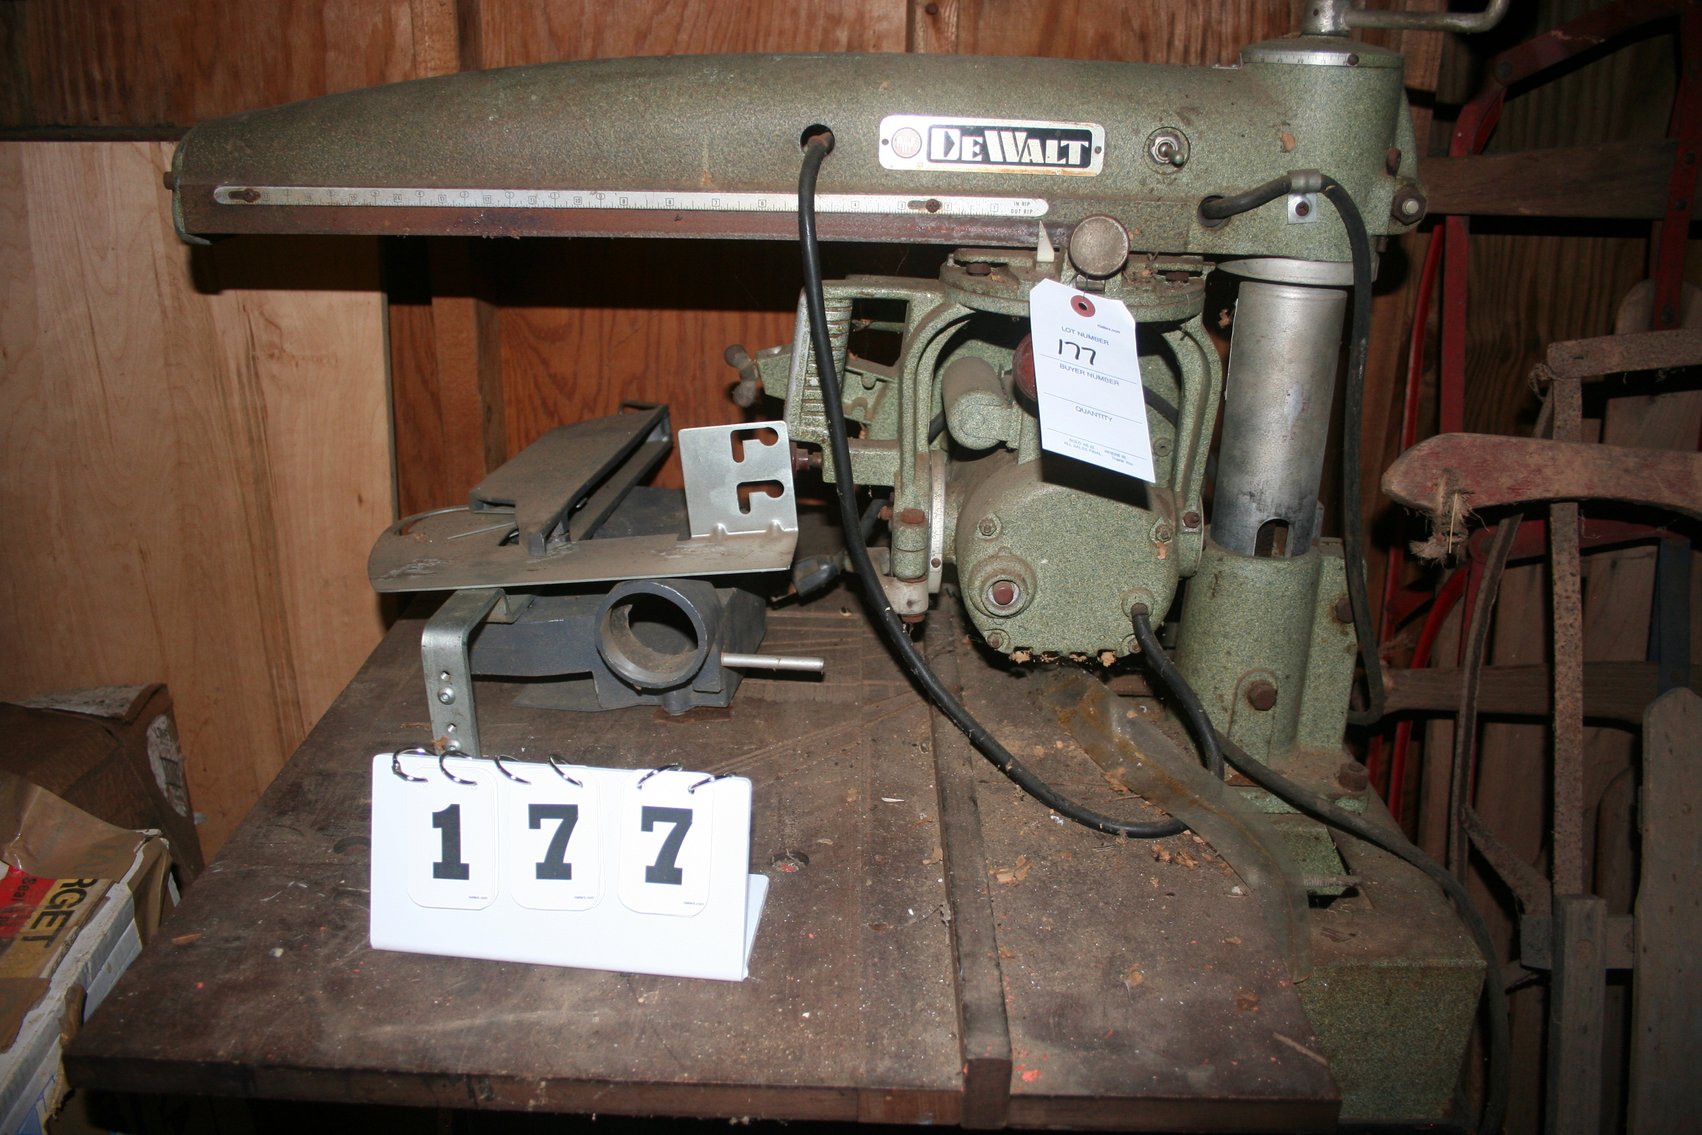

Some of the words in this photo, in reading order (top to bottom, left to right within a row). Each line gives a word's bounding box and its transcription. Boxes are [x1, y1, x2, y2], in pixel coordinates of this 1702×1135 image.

[1061, 325, 1075, 335] LOT
[1077, 331, 1109, 346] NUMBER
[1058, 338, 1096, 366] 177
[1060, 362, 1086, 376] BUYER
[1086, 371, 1120, 386] NUMBER
[1075, 405, 1113, 422] QUANTITY
